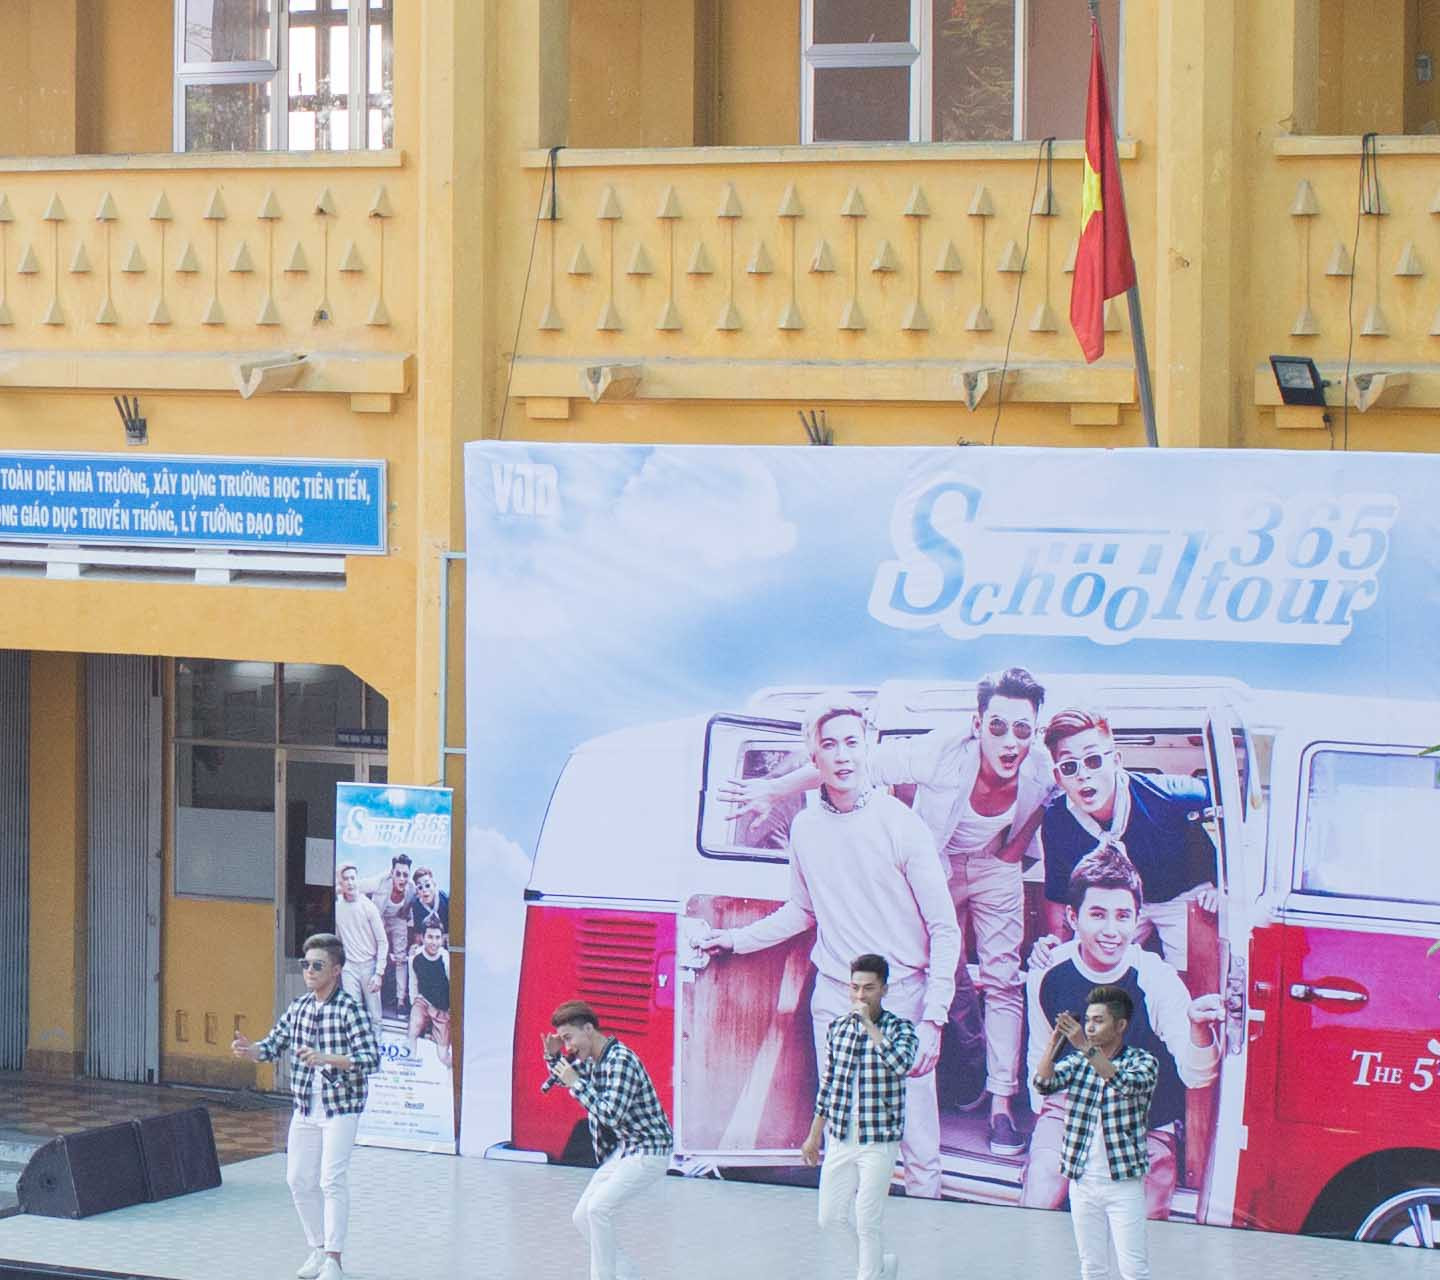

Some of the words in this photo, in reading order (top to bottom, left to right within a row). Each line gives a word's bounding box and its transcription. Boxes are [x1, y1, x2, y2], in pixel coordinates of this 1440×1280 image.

[0, 463, 33, 492] TOÀN
[35, 464, 66, 496] DIỆN
[68, 465, 94, 493] NHÀ
[96, 466, 150, 499] TRƯỜNG,
[152, 467, 178, 496] XÂY
[181, 470, 217, 500] DỰNG
[219, 470, 271, 499] TRƯỜNG
[272, 476, 301, 503] HỌC
[302, 472, 334, 501] TIÊN
[336, 469, 372, 505] TIẾN,
[20, 500, 49, 528] GIÁO
[52, 506, 78, 533] DỤC
[132, 500, 178, 536] THỐNG,
[181, 504, 197, 533] LÝ
[201, 503, 244, 535] TƯỞNG
[246, 512, 273, 539] ĐẠO
[276, 508, 304, 537] ĐỨC
[1230, 499, 1396, 570] 365
